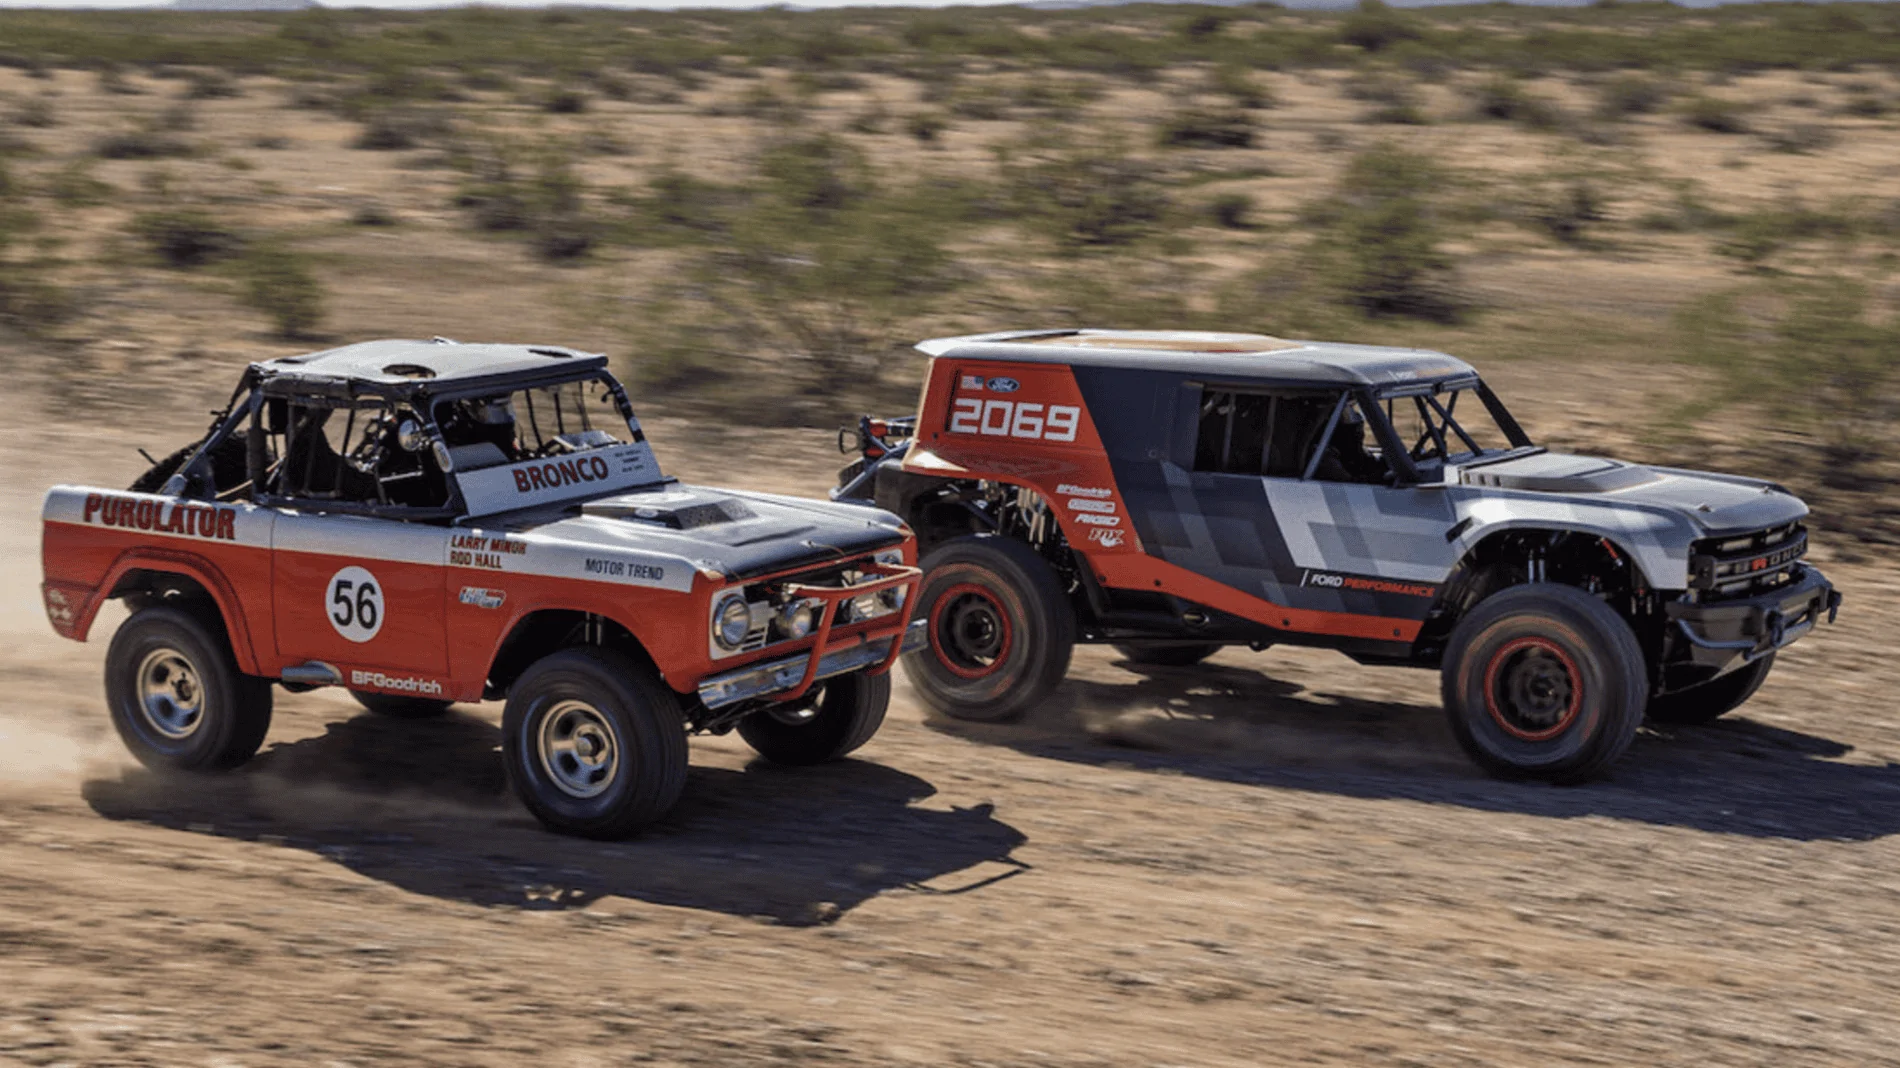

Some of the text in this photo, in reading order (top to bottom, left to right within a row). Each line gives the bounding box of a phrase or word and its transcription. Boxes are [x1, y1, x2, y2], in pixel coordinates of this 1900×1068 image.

[951, 398, 1080, 442] 2069
[512, 456, 608, 493] BRONCO
[84, 493, 235, 539] PUROLATOR
[451, 534, 527, 554] LARRY MINOR
[450, 550, 502, 568] ROD HALL
[585, 558, 664, 580] MOTOR TREND
[1310, 574, 1435, 597] FORD PERFORMANCE
[332, 579, 378, 630] 56
[351, 669, 442, 695] BFGoodrich
